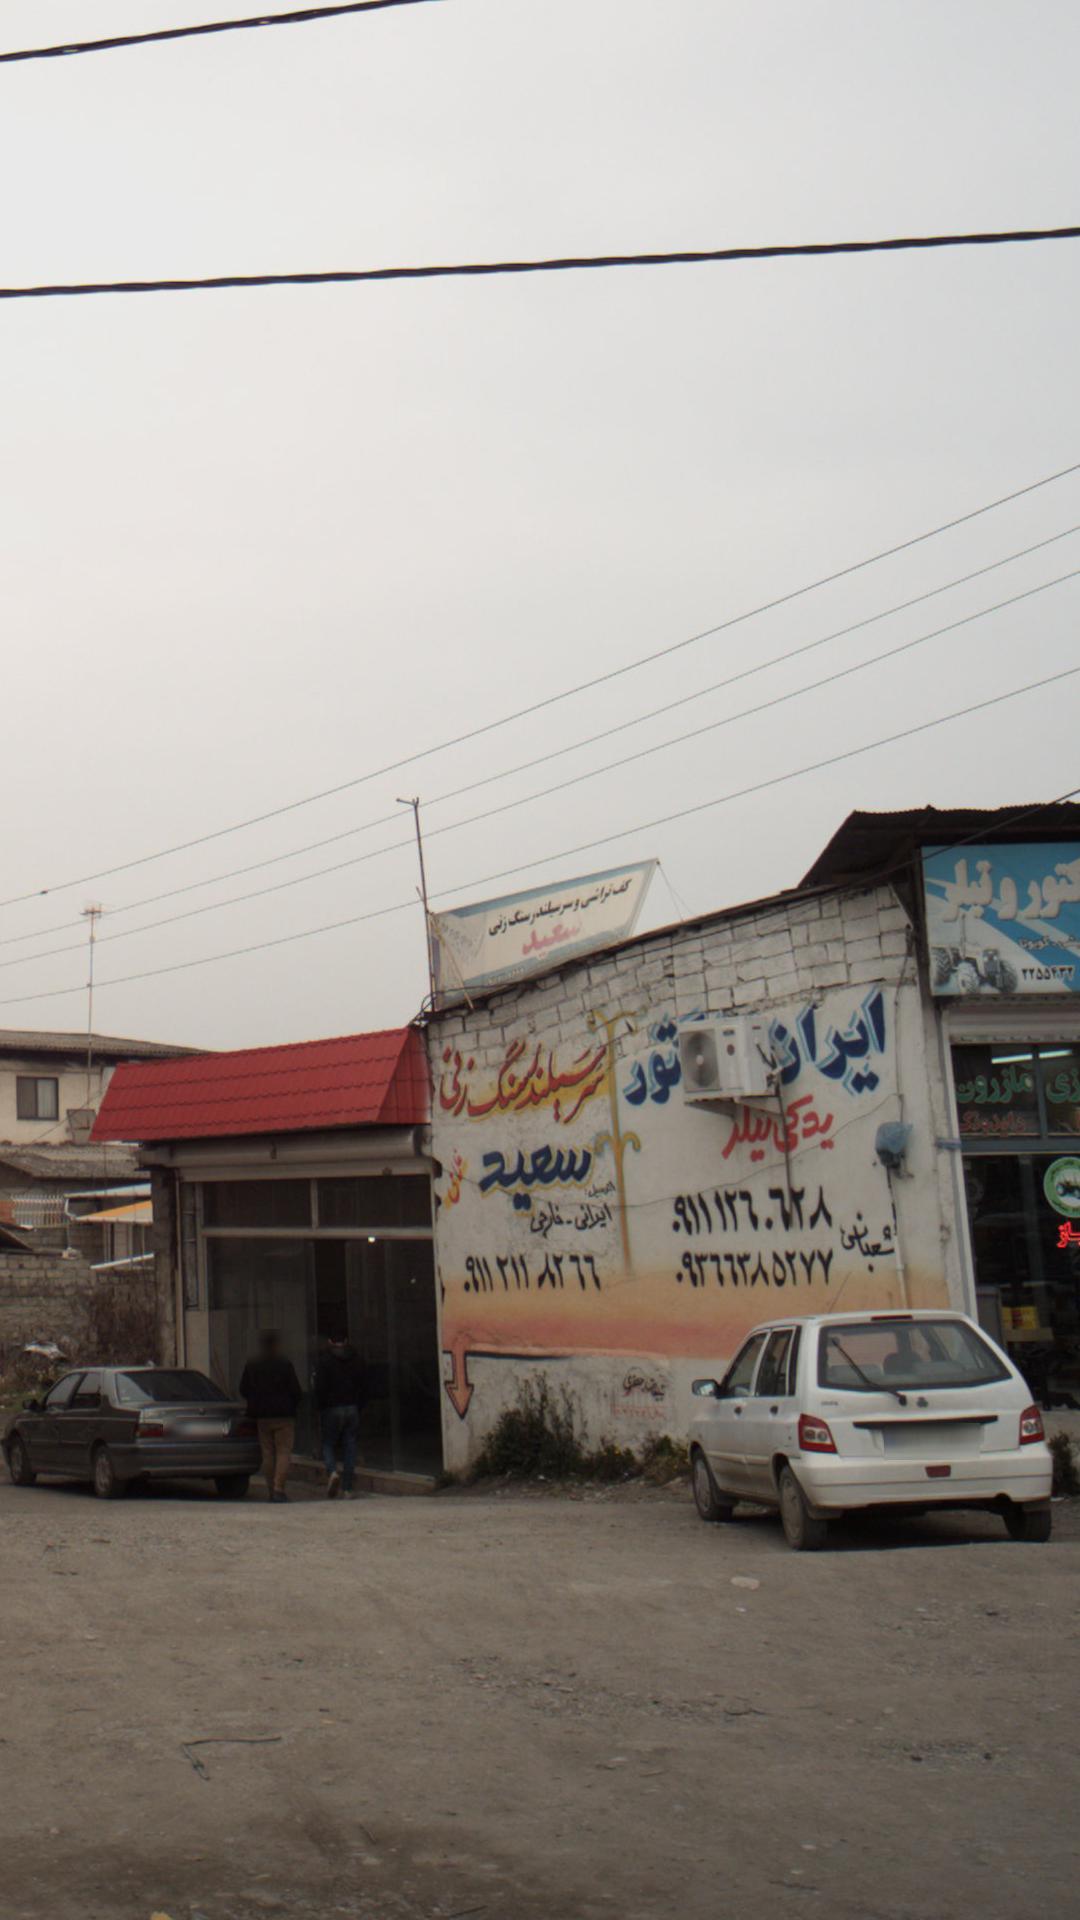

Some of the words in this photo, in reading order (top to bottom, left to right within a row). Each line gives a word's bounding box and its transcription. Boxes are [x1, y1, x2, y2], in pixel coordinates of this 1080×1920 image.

[768, 985, 886, 1095] ایران
[773, 1093, 835, 1153] یدکی
[478, 1144, 593, 1211] سعید
